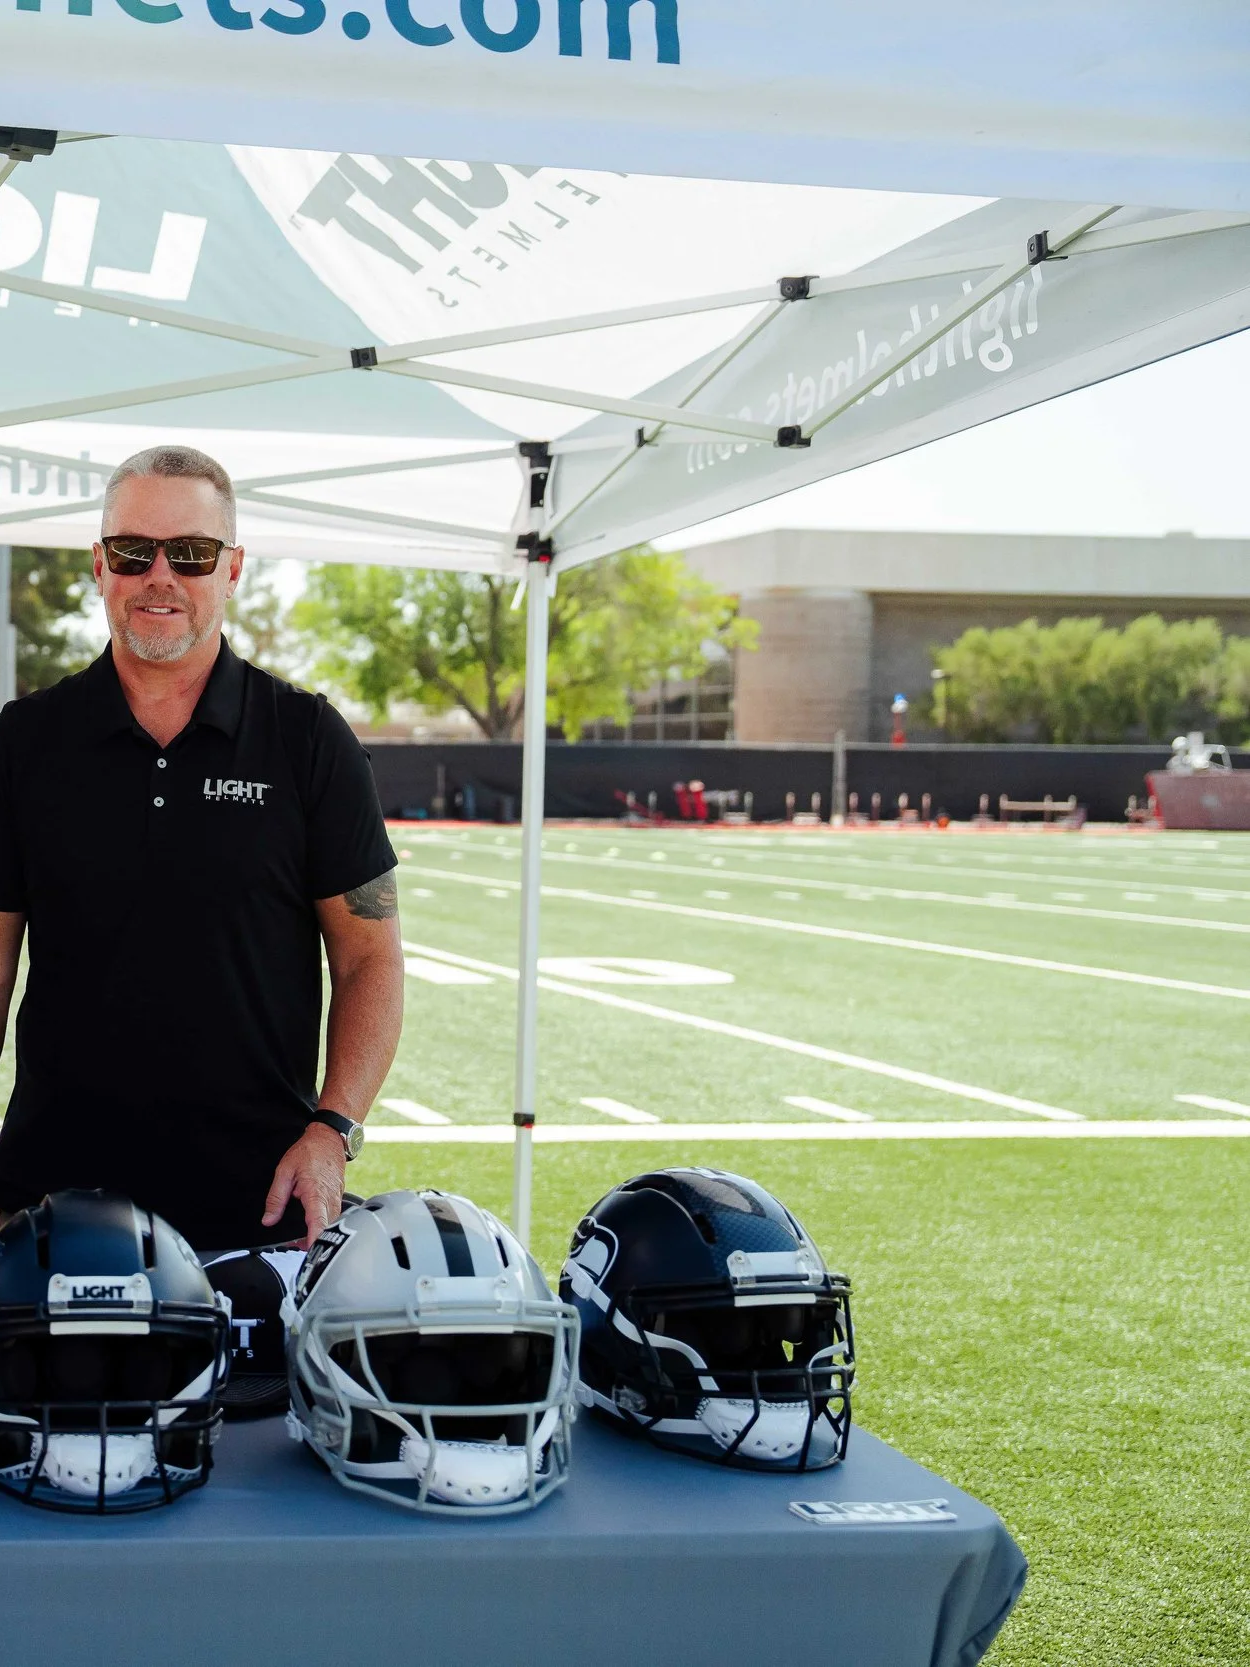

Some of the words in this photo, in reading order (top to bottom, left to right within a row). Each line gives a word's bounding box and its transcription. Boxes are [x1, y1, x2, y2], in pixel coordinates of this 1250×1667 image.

[203, 778, 268, 799] LIGHT
[205, 795, 264, 806] HELMETS
[72, 1286, 126, 1299] LIGHT
[797, 1500, 936, 1515] LIGHT
